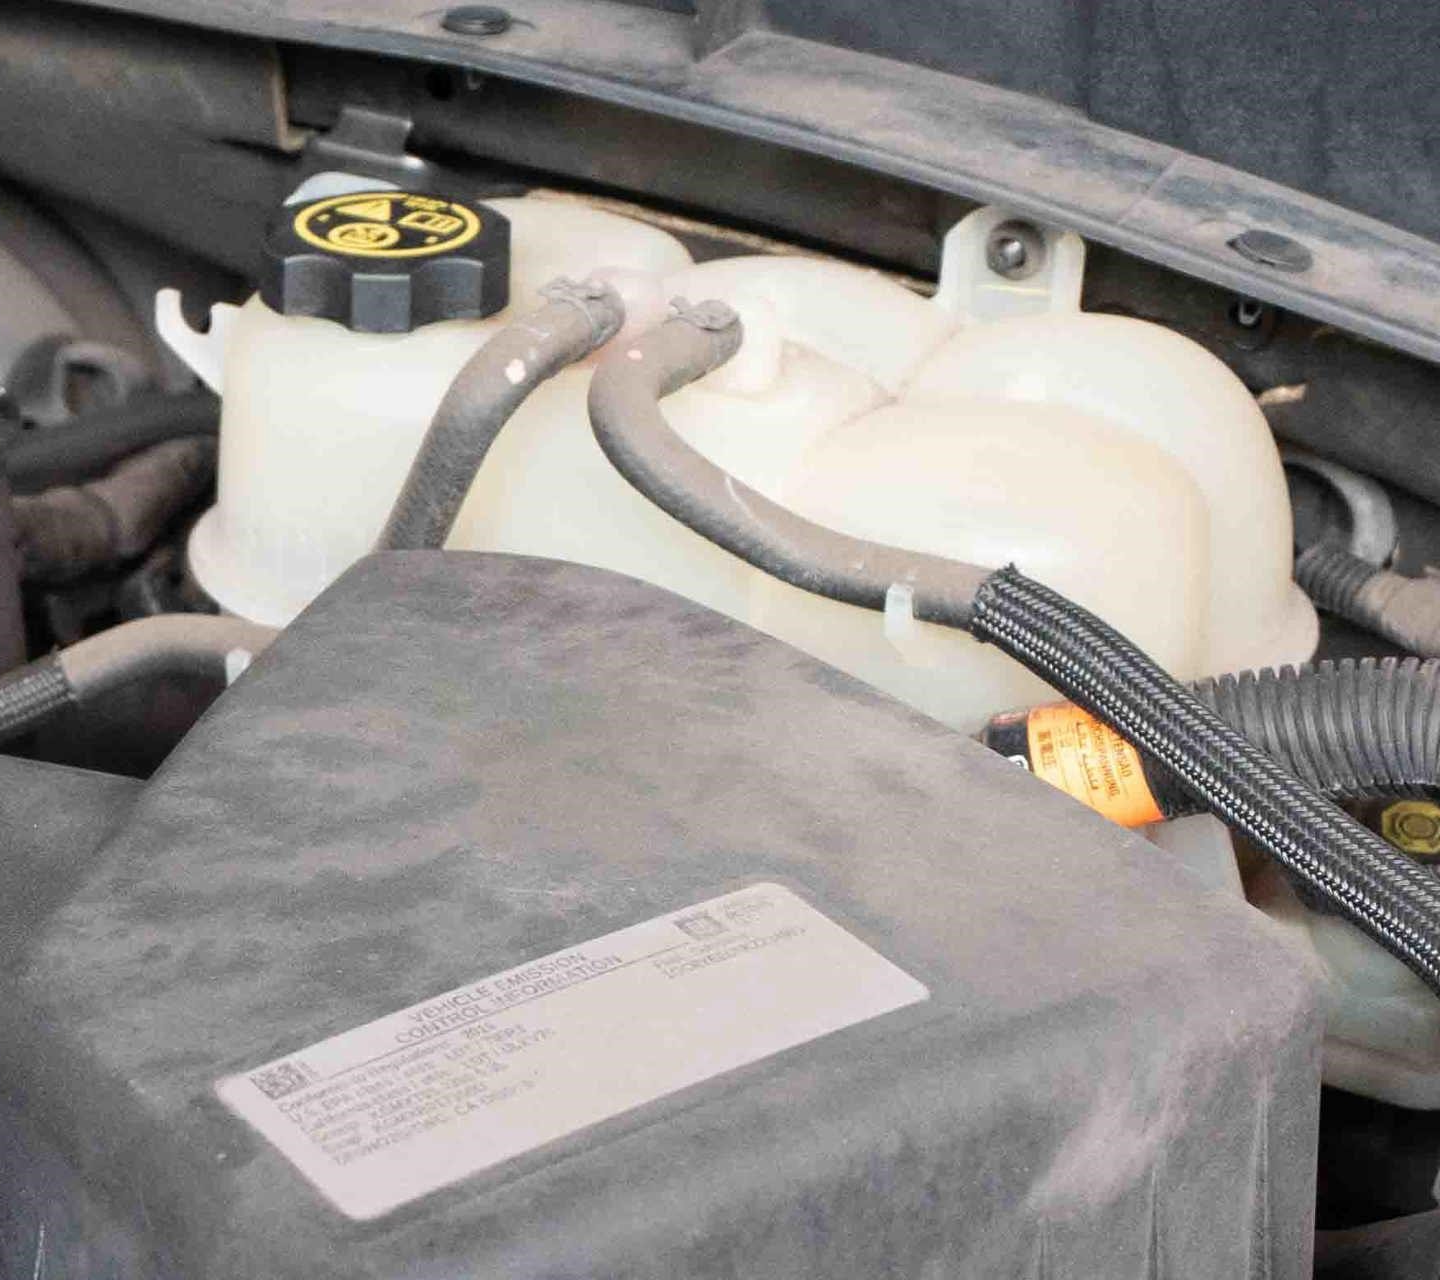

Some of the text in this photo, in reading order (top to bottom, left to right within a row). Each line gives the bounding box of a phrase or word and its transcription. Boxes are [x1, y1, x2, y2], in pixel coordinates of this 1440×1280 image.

[394, 953, 624, 1044] CONTROL INFORMATION
[407, 951, 588, 1023] VEHICLE EMISSION
